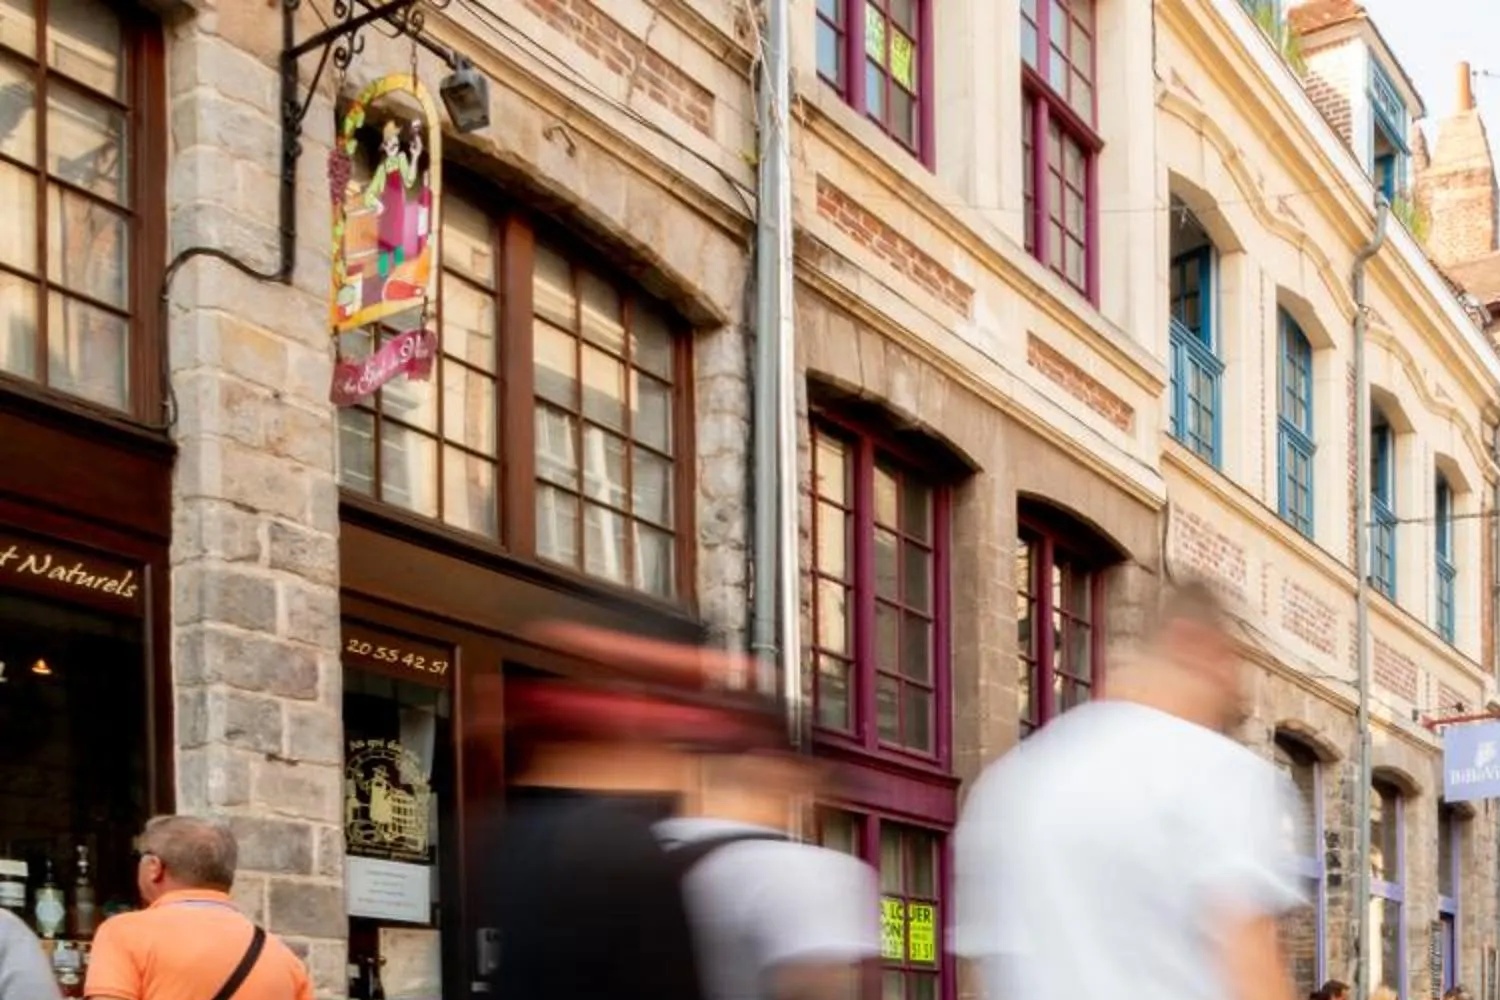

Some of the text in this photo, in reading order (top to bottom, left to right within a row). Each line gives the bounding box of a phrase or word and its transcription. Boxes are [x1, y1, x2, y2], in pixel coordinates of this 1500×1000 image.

[16, 553, 139, 598] Naturels
[346, 639, 449, 675] 20 55 42 51
